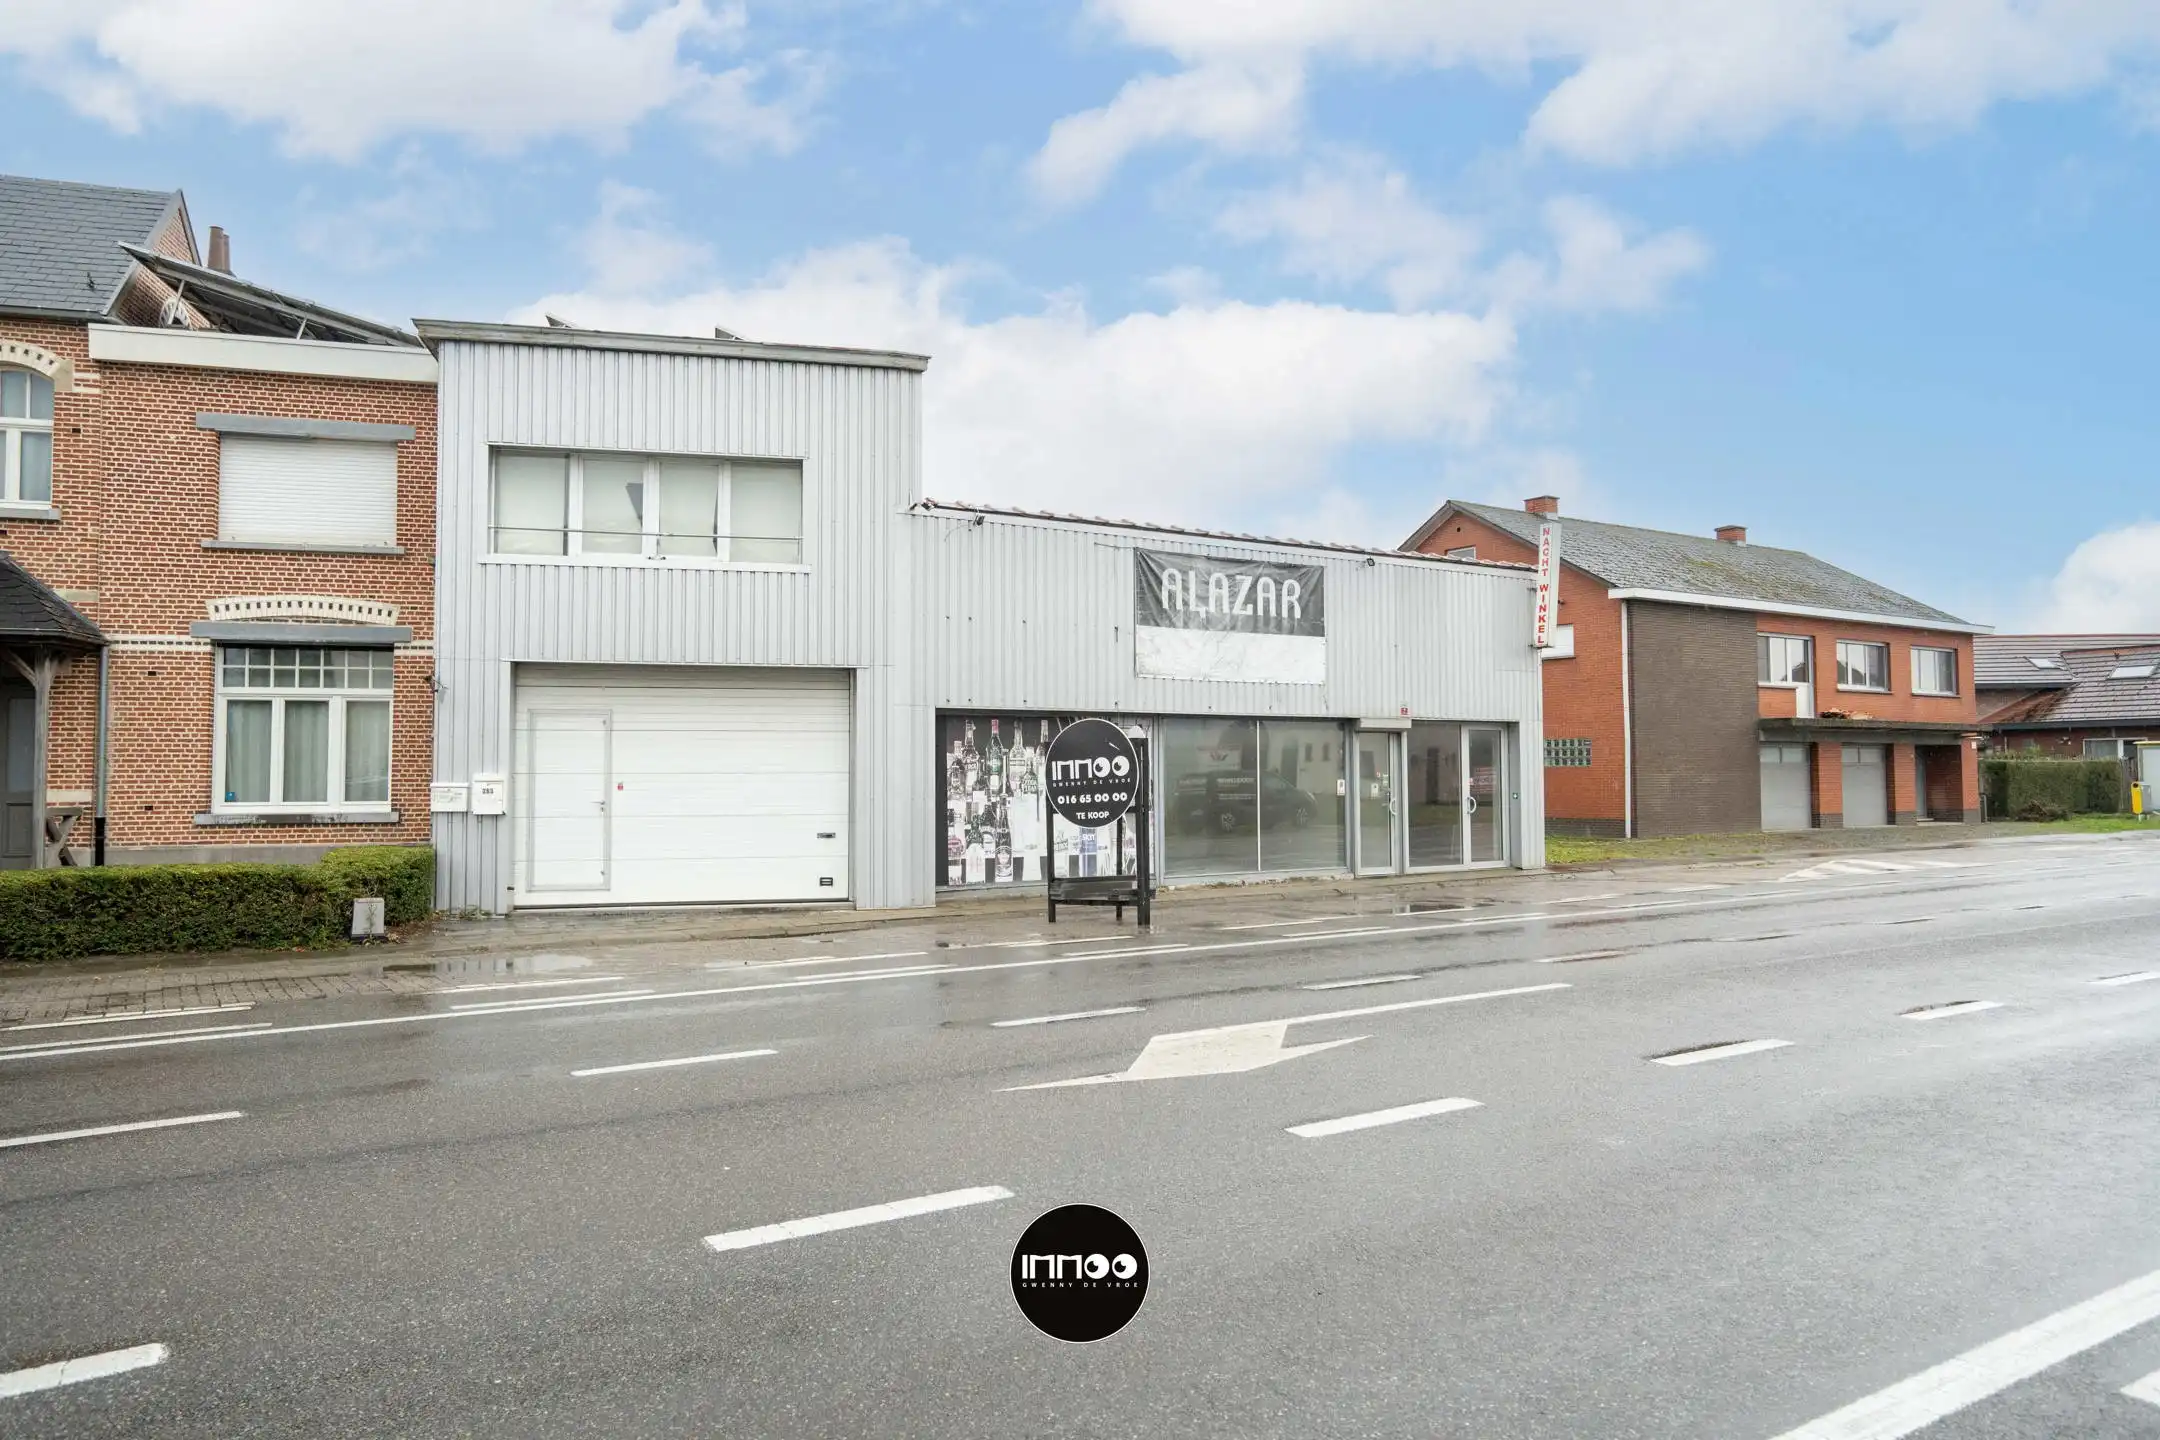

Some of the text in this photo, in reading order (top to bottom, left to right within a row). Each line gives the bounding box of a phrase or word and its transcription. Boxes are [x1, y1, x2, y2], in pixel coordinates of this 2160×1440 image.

[1541, 527, 1551, 577] NACHT
[1161, 568, 1302, 619] ALAZAR
[1537, 584, 1549, 644] WINKEL
[1057, 792, 1128, 805] 016 65 00 00
[1076, 810, 1110, 820] TE KOOP
